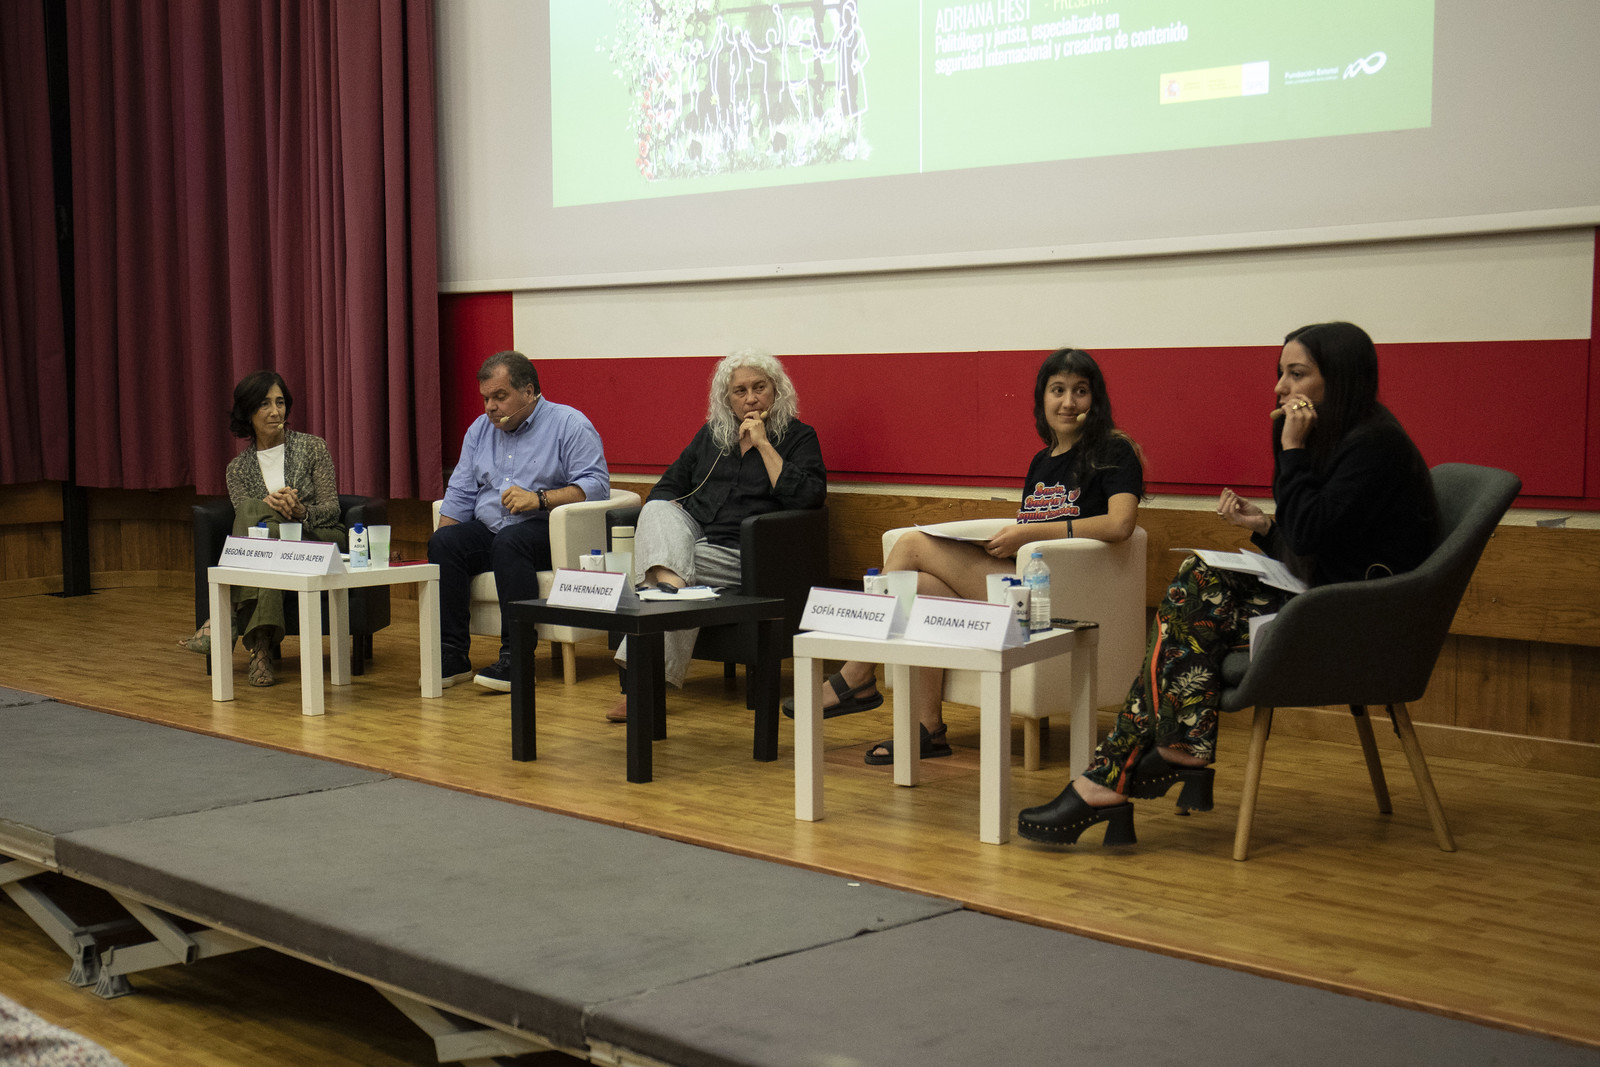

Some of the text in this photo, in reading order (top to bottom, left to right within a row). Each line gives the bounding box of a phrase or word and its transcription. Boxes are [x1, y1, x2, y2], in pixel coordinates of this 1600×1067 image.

[936, 1, 995, 34] ADRIANA
[936, 31, 984, 54] Politóloga
[985, 32, 993, 52] y
[1032, 11, 1103, 42] especializada
[1105, 12, 1120, 29] en
[935, 20, 1189, 76] seguridad internacional y creadora de contenido
[224, 547, 274, 559] BEGOÑA DE BENITO
[280, 552, 324, 563] JOSÉ LUIS ALPERI
[559, 583, 613, 596] EVA HERNÁNDEZ
[811, 605, 885, 623] SOFÍA FERNÁNDEZ
[923, 615, 991, 631] ADRIANA HEST
